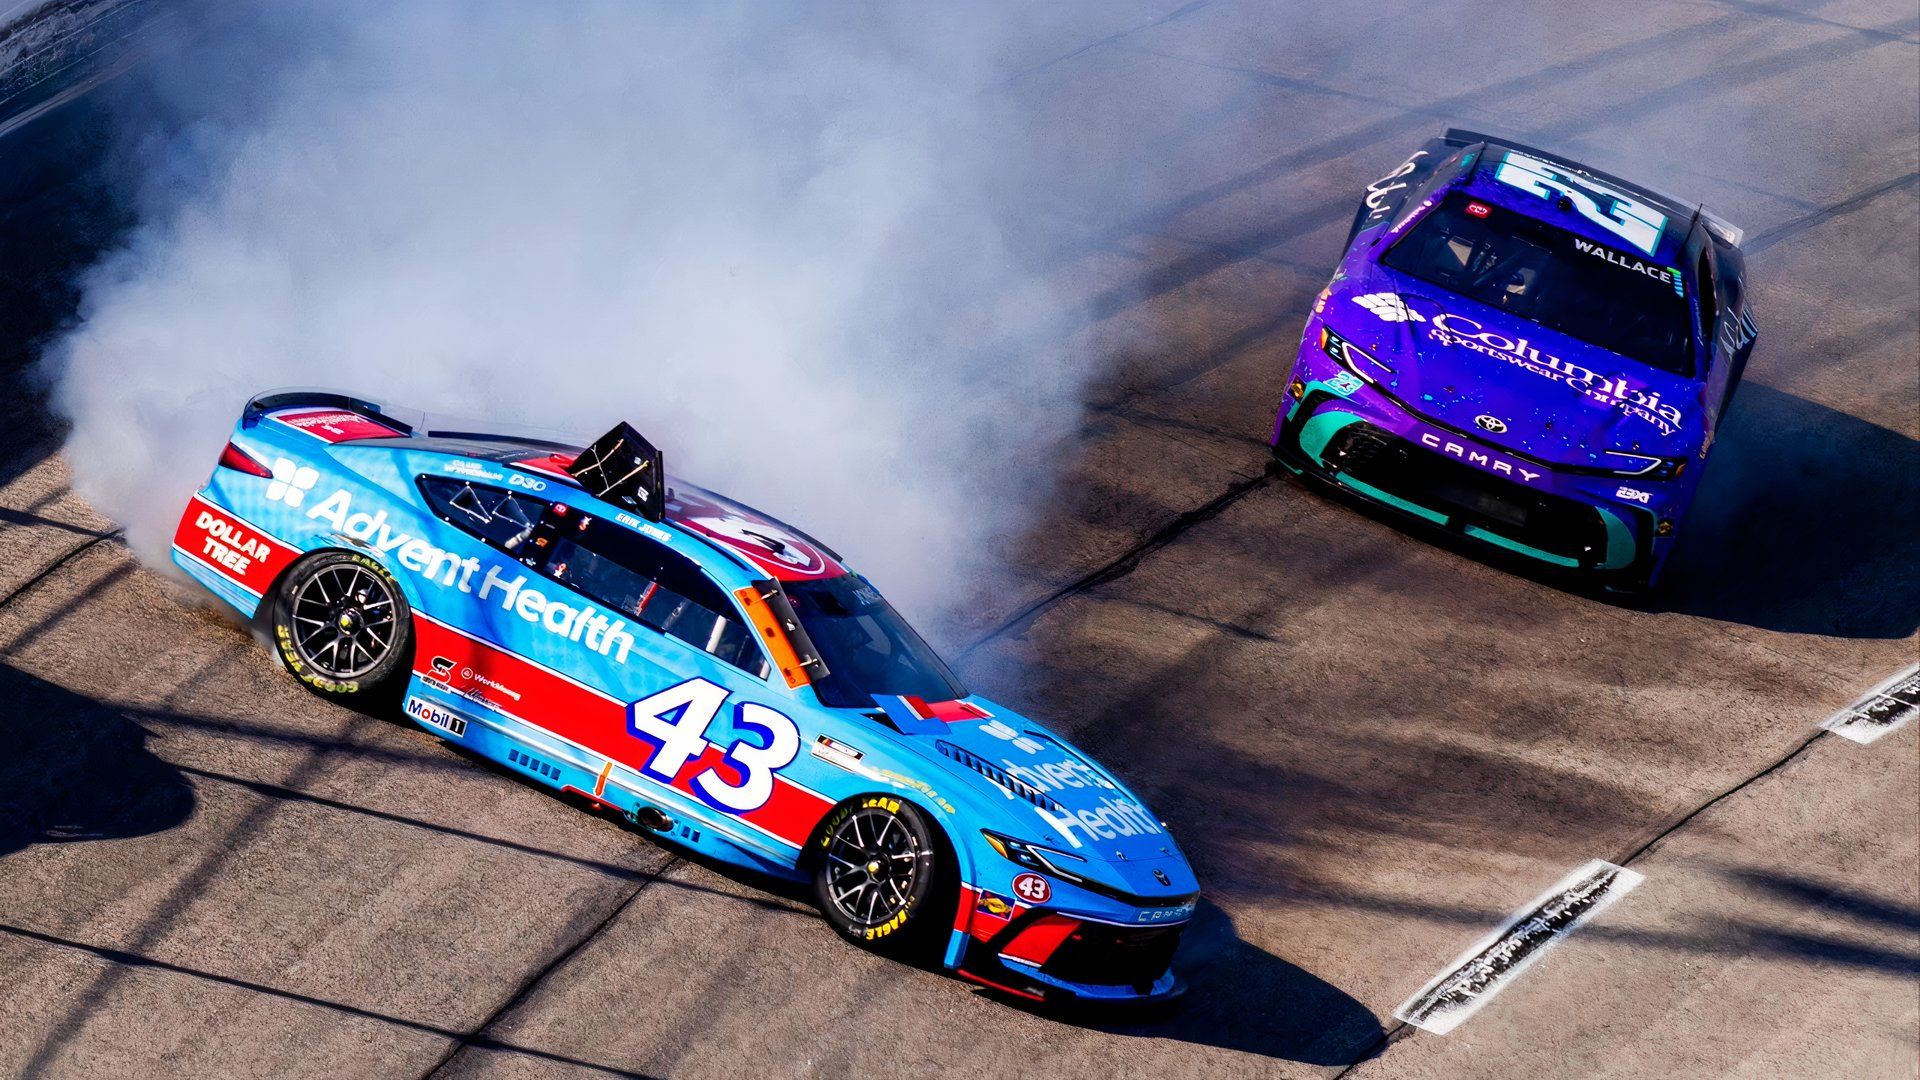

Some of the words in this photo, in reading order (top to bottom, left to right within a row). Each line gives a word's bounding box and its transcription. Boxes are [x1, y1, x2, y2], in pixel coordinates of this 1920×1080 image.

[1574, 238, 1672, 284] WALLACE
[1428, 327, 1565, 382] Sportswear
[1566, 375, 1676, 436] Company
[1432, 313, 1682, 430] Columbia
[1421, 432, 1541, 482] CAMRY
[195, 511, 271, 563] DOLLAR
[202, 536, 251, 576] TREE
[408, 699, 449, 728] Mobil
[626, 676, 801, 815] 43
[1017, 875, 1047, 900] 43
[865, 909, 909, 941] EAGLE
